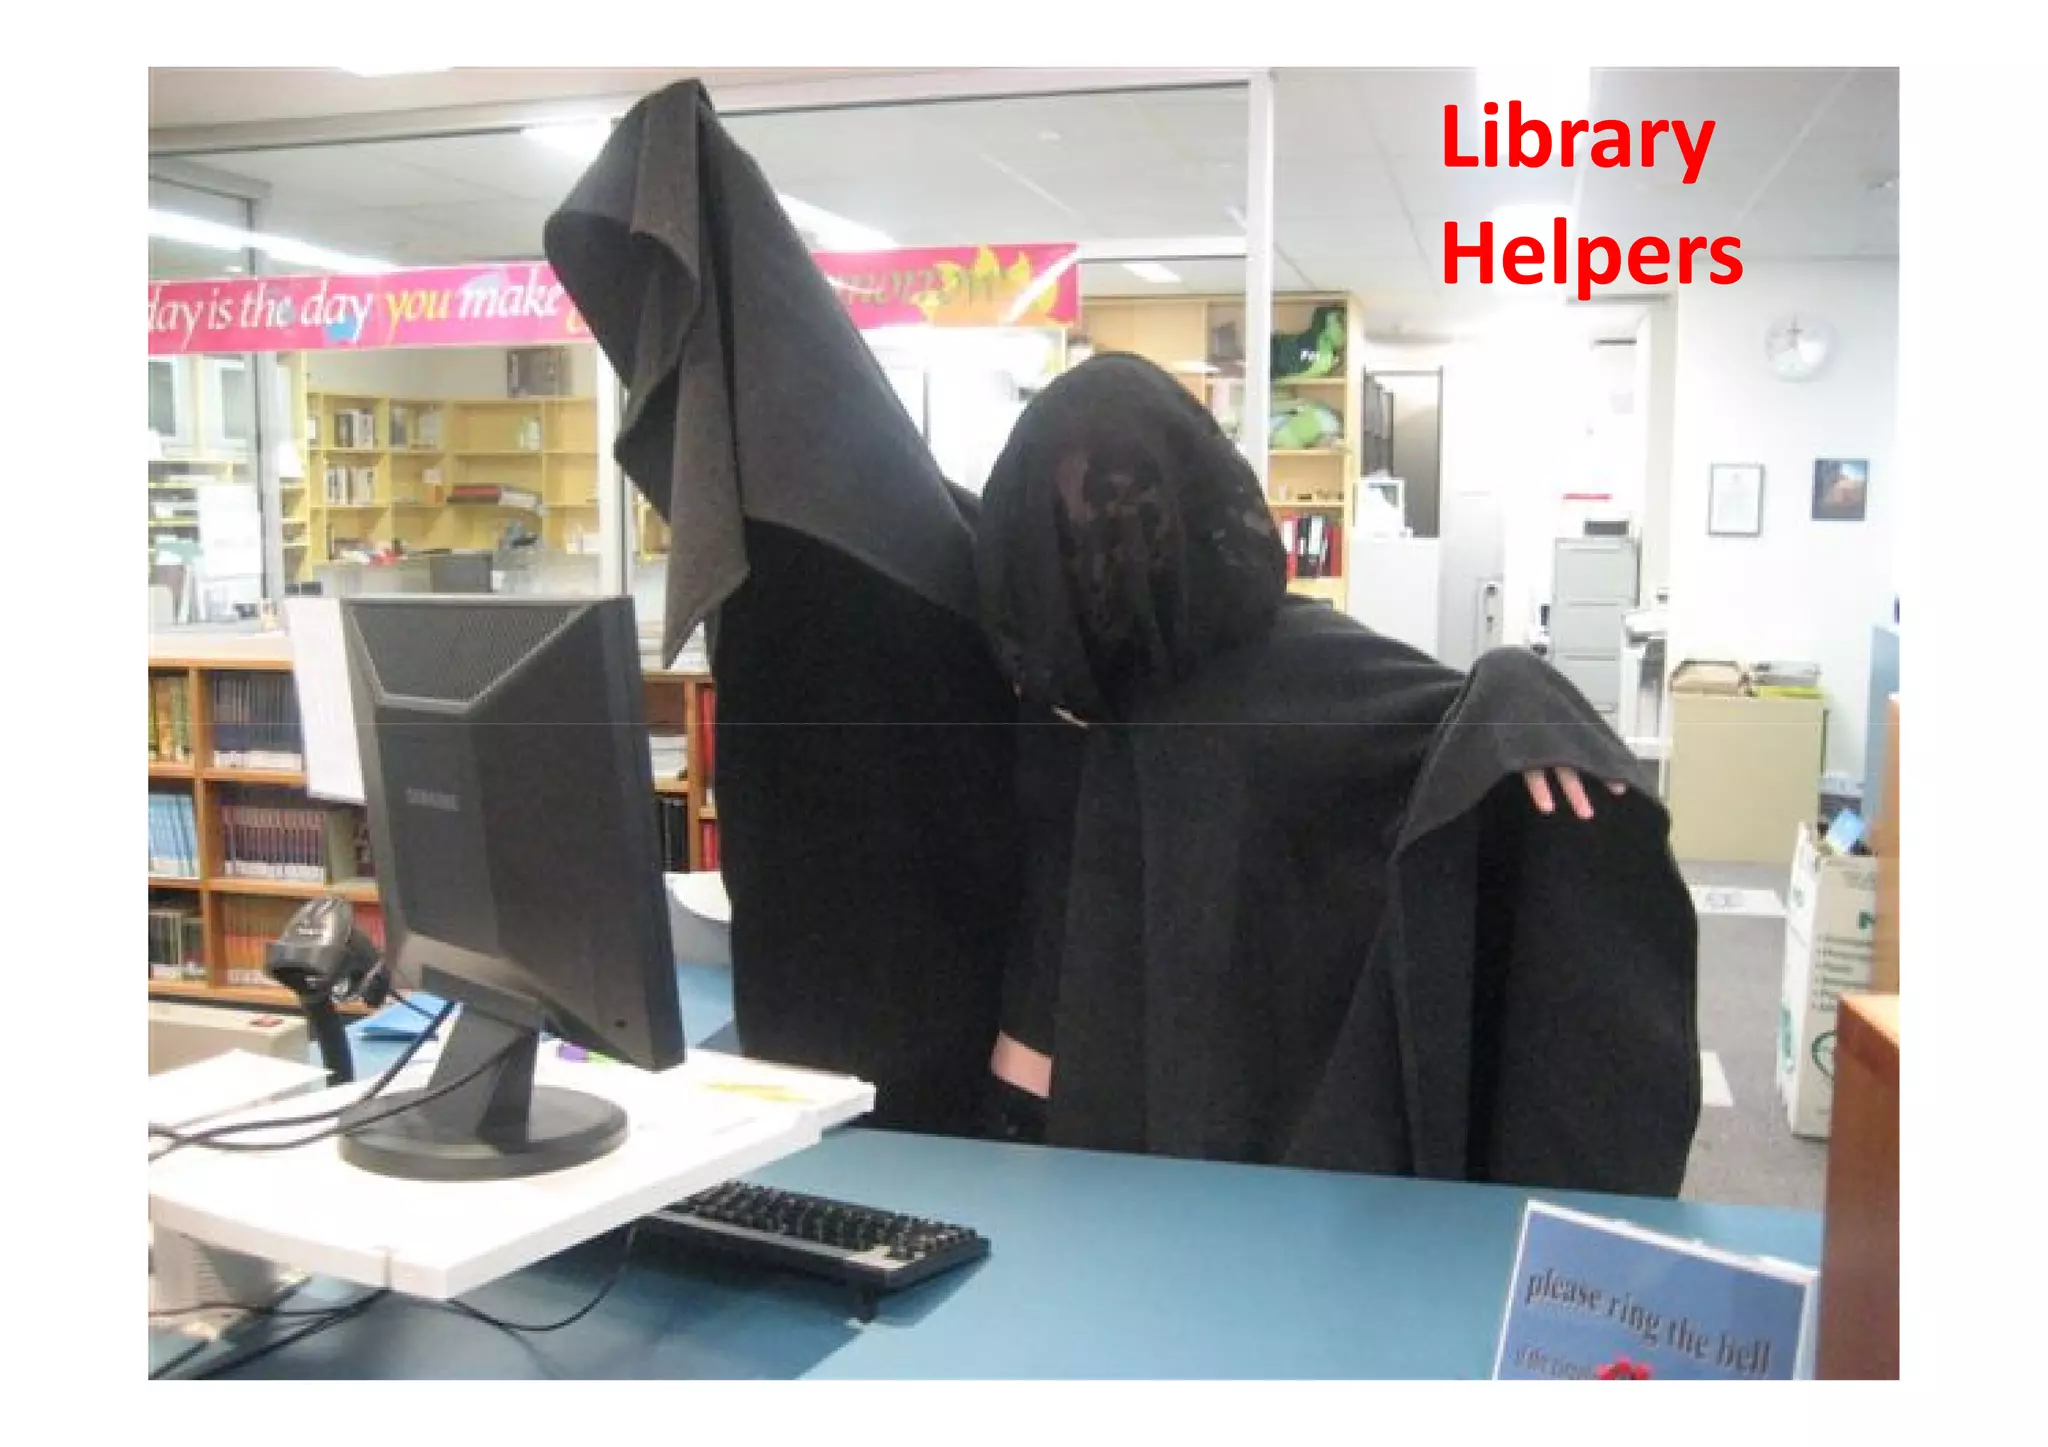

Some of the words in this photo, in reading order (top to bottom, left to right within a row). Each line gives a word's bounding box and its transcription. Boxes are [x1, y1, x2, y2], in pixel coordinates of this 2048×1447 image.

[208, 287, 234, 329] is
[241, 281, 294, 329] the
[301, 278, 374, 343] day
[386, 288, 449, 345] you
[459, 267, 564, 319] make
[1525, 1268, 1600, 1310] please
[1608, 1292, 1660, 1341] ring
[1667, 1316, 1711, 1360] the
[1716, 1332, 1771, 1374] bell
